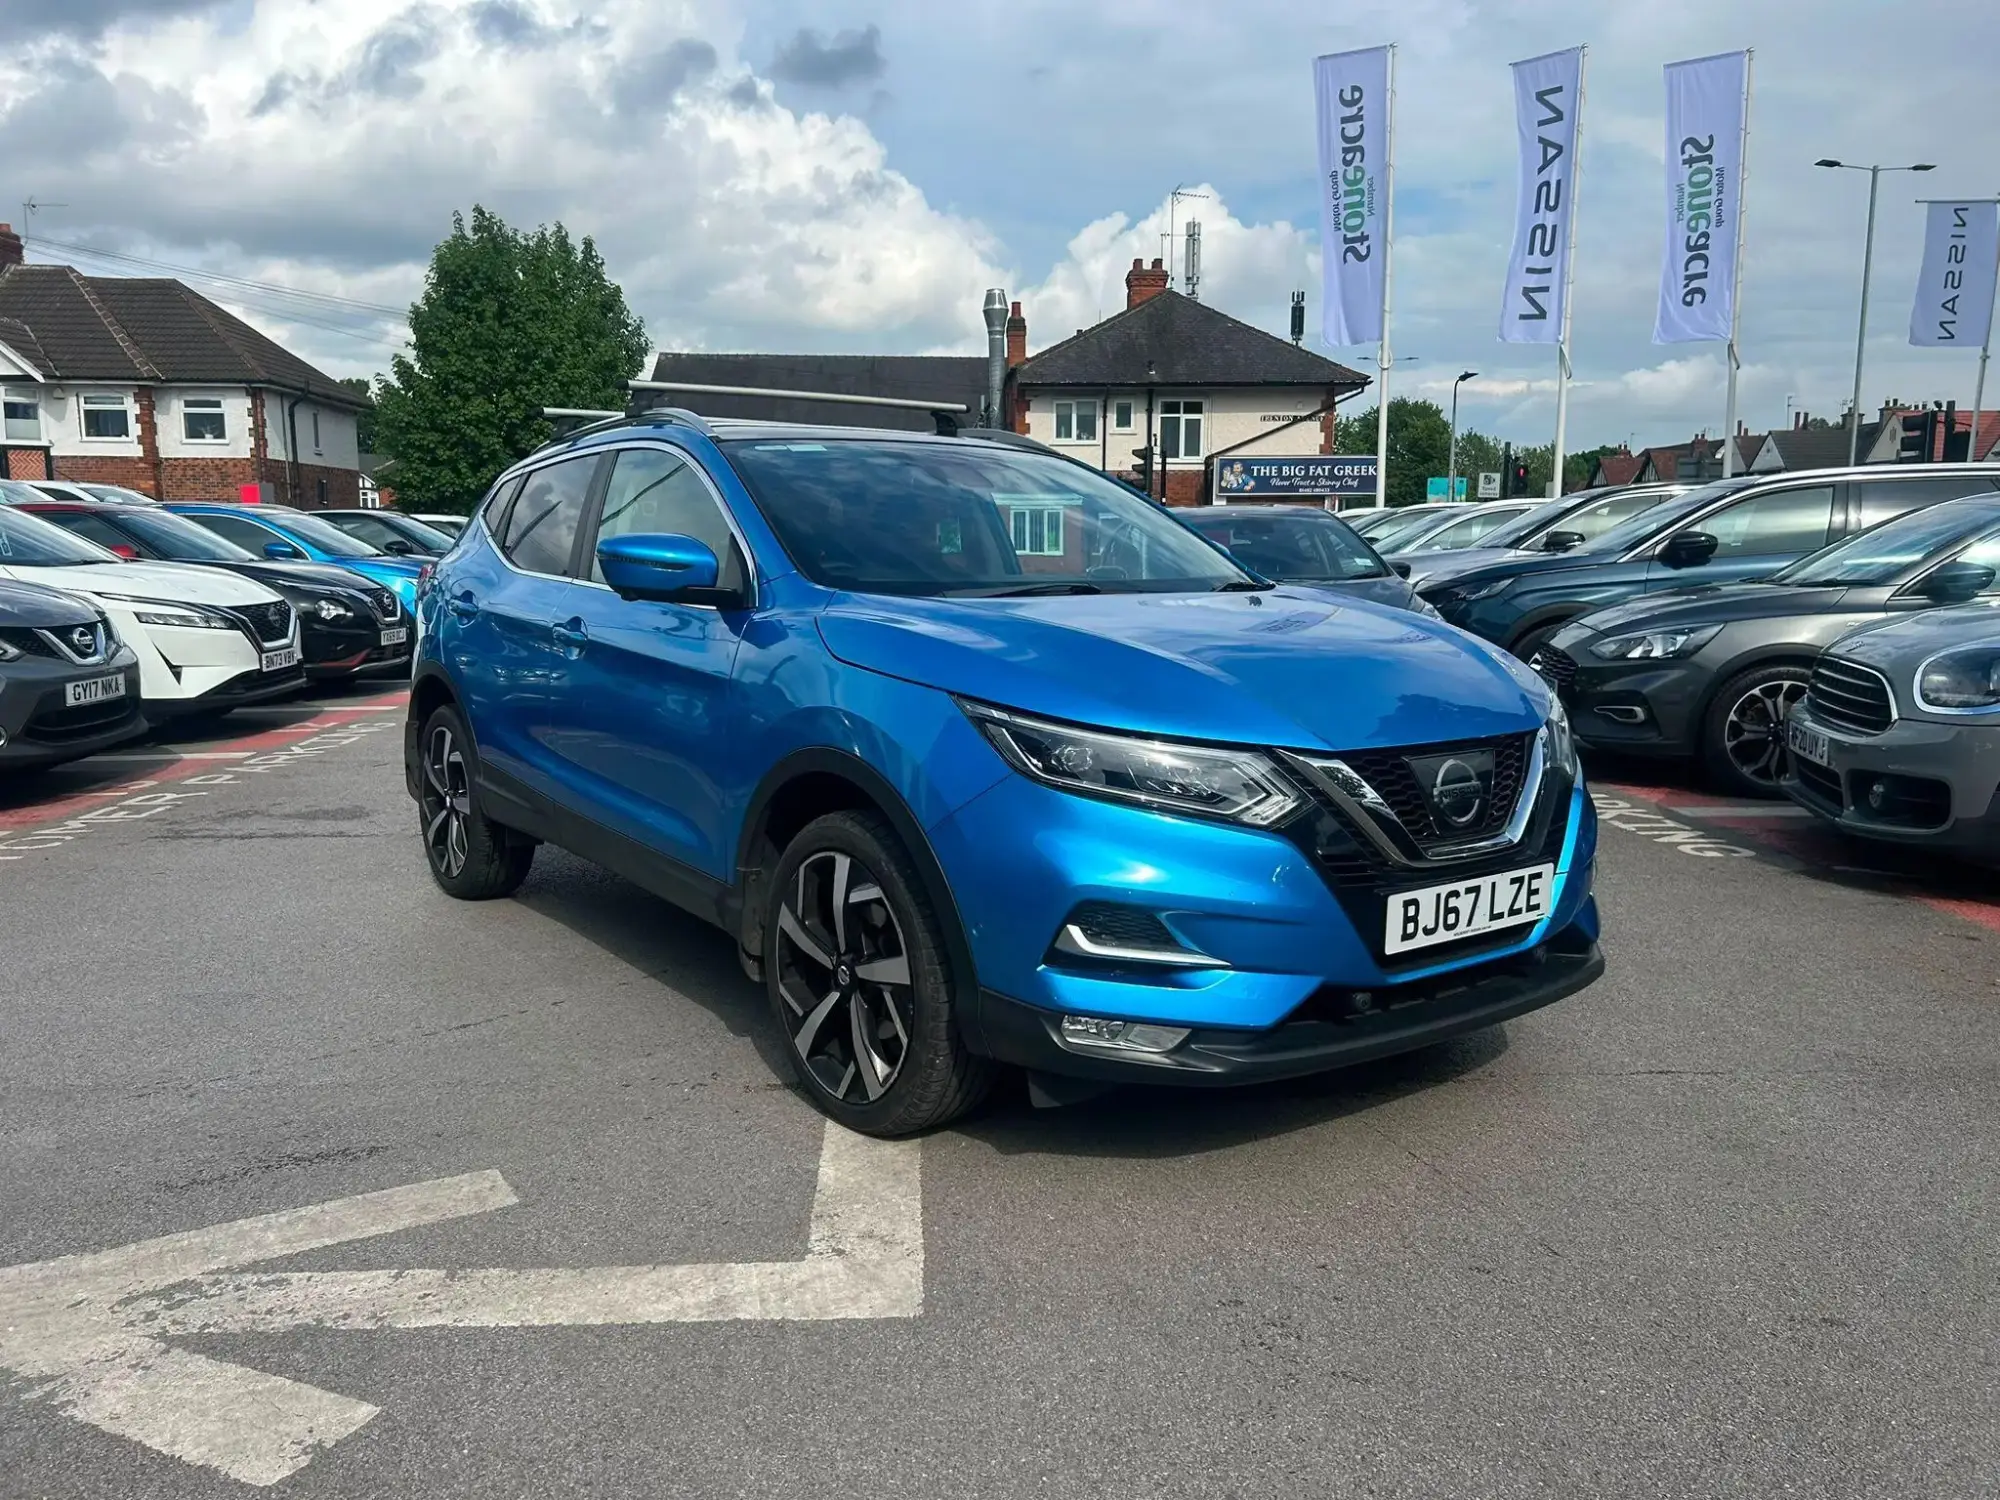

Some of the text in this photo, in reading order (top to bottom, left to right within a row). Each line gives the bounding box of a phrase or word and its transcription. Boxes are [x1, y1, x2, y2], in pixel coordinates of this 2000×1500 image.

[1250, 465, 1377, 476] THE BIG FAT GREEK
[1269, 478, 1290, 487] Never
[1317, 477, 1340, 489] Skinny
[1342, 477, 1360, 488] Chef
[73, 676, 120, 702] GY17 NKA
[0, 722, 397, 860] OMER PARKING
[1400, 871, 1543, 942] BJ67 LZE
